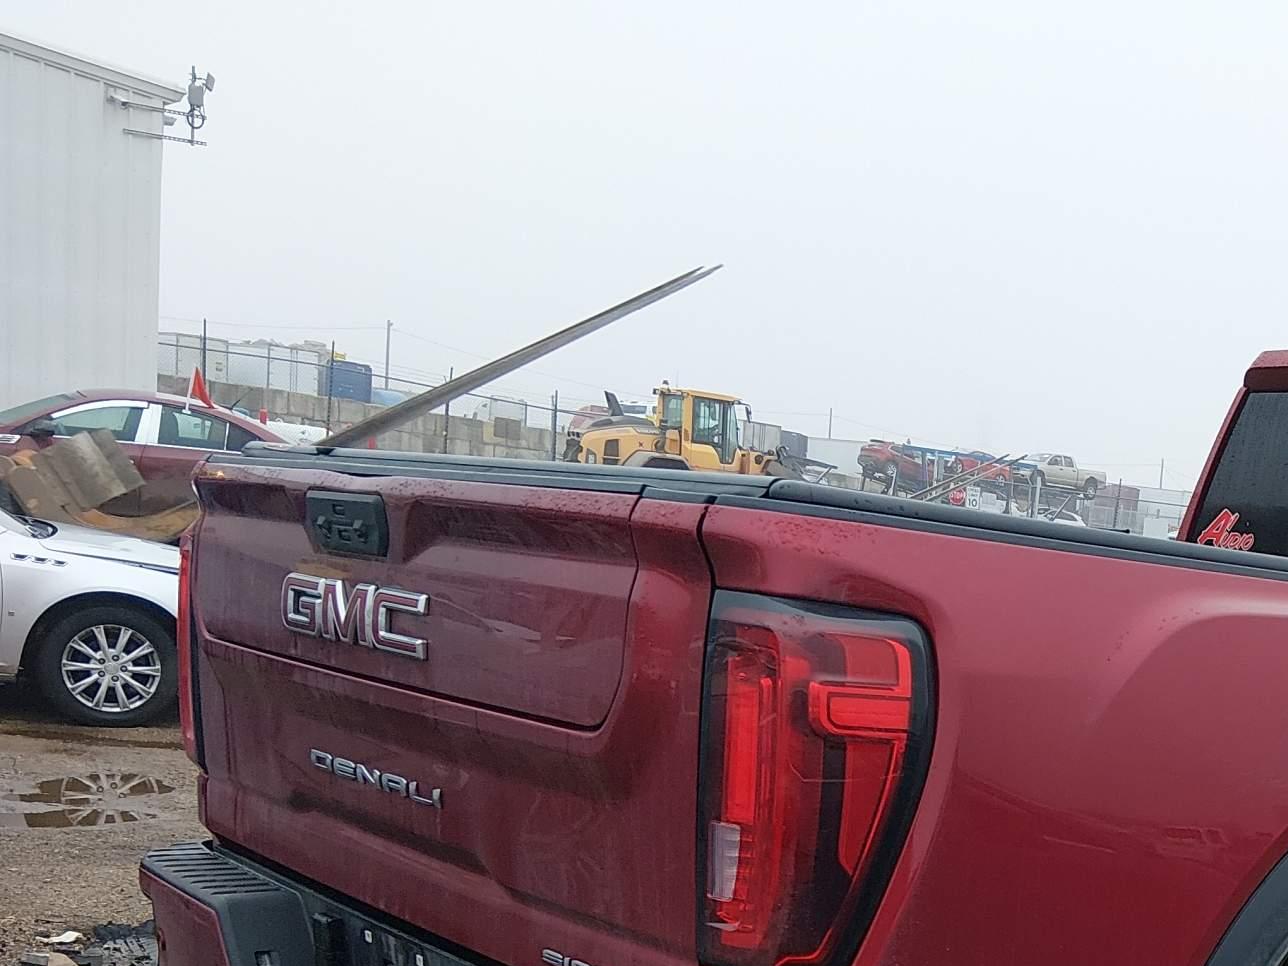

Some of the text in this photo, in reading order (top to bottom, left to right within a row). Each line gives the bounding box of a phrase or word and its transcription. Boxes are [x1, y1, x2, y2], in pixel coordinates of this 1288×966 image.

[968, 498, 978, 508] 10
[281, 572, 430, 660] GMC
[310, 748, 442, 808] DENALI
